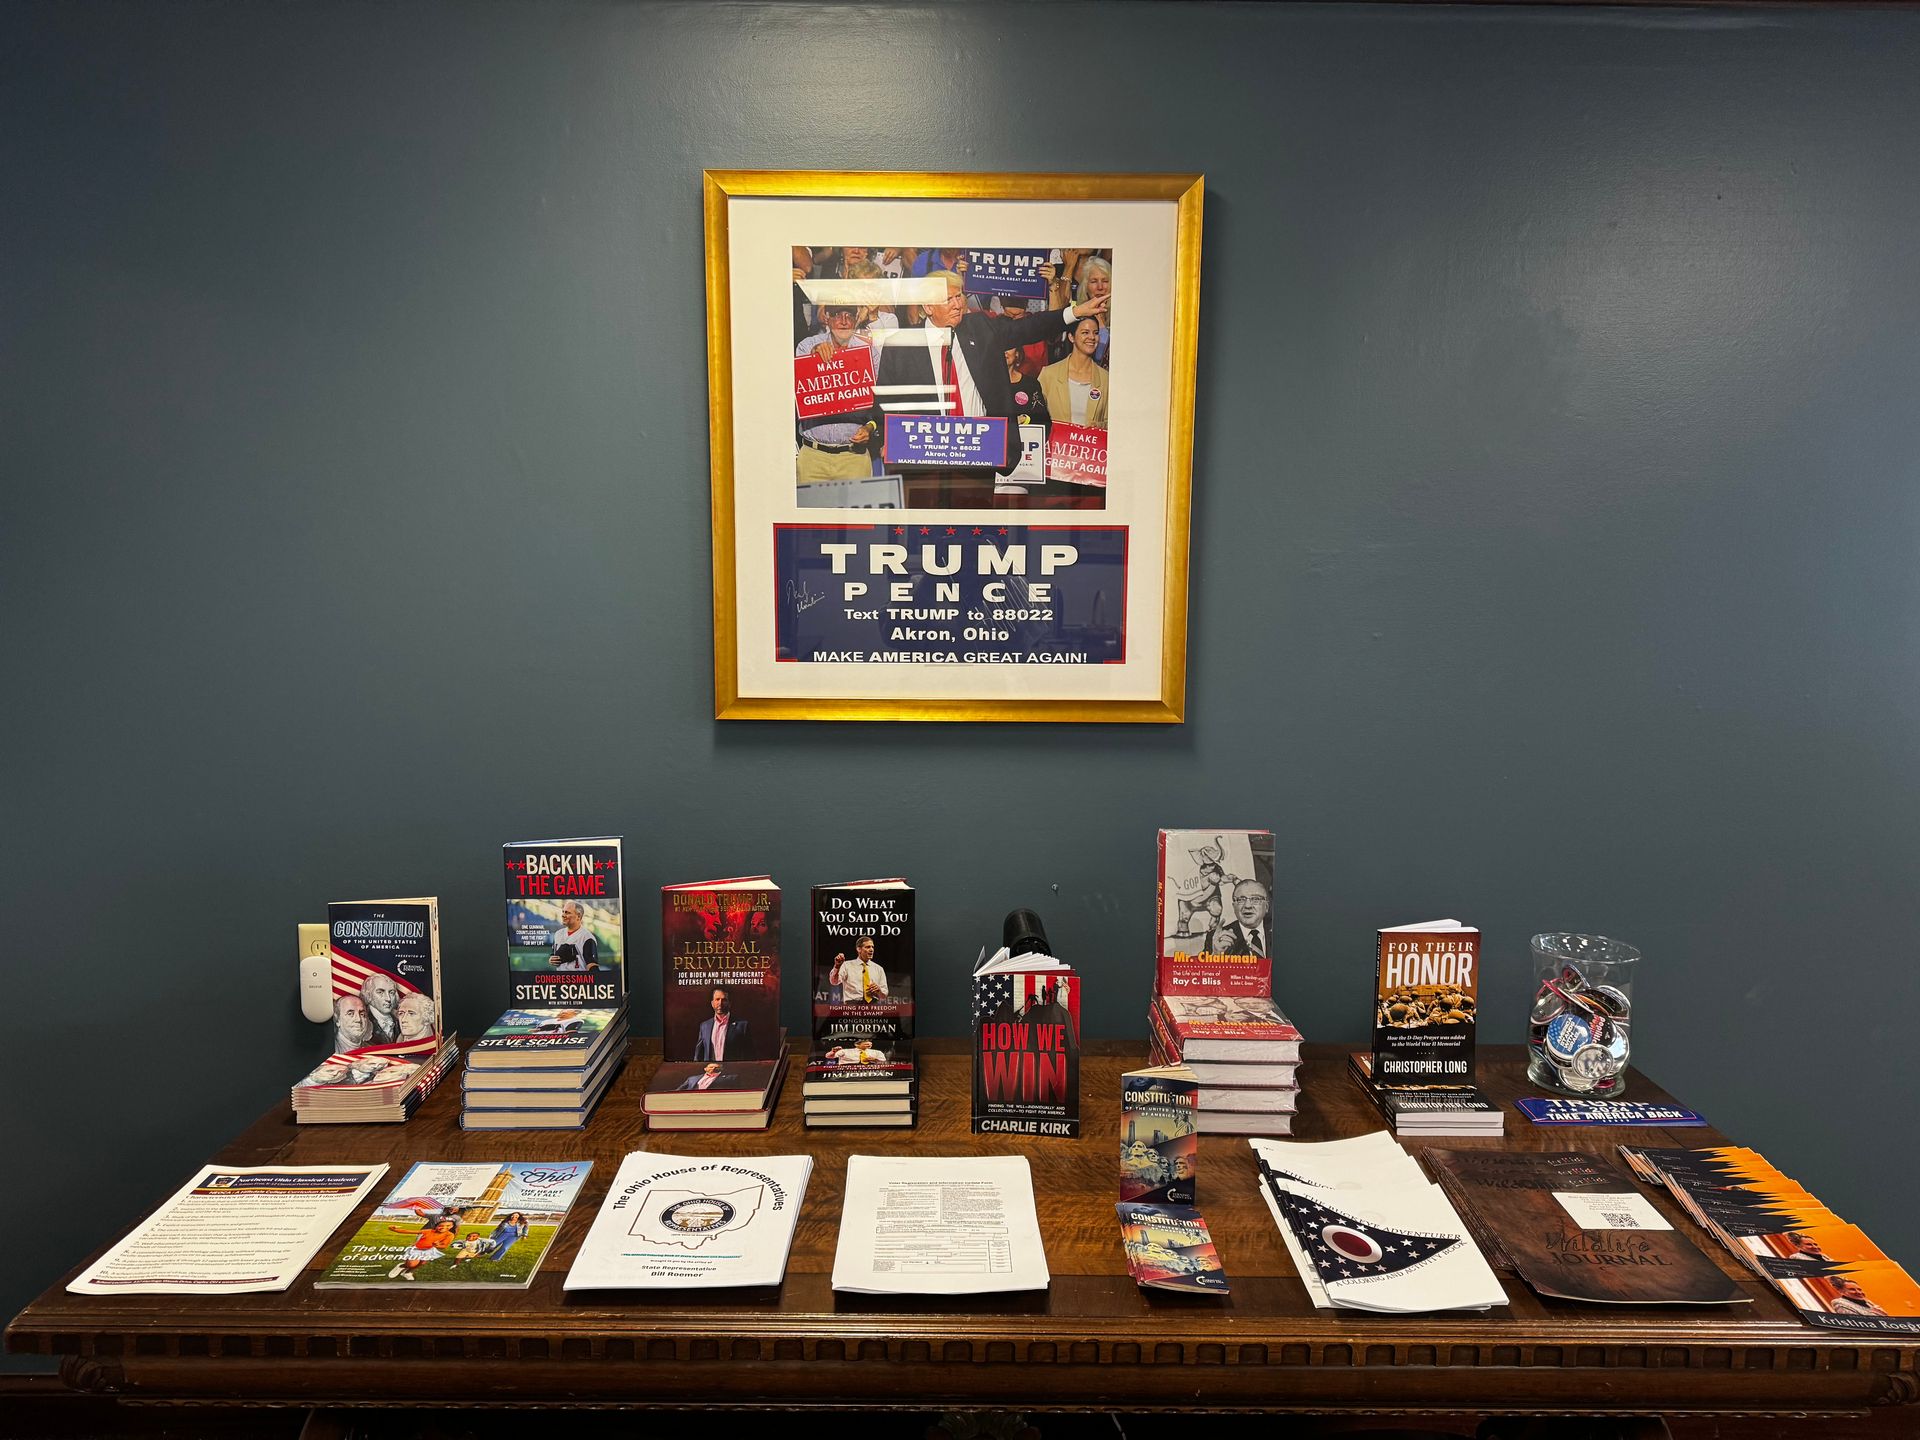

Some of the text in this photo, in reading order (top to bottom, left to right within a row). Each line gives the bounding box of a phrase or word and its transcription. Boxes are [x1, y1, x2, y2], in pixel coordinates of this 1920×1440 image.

[970, 252, 1044, 267] TRUMP
[975, 265, 1036, 276] PENCE
[817, 360, 845, 372] MAKE
[796, 369, 873, 394] AMERICA
[803, 386, 870, 406] GREAT AGAIN
[901, 421, 990, 435] TRUMP
[909, 435, 980, 444] PENCE
[1070, 432, 1098, 444] MAKE
[1045, 440, 1107, 463] AMERIC
[1046, 458, 1107, 475] GREAT AGAI
[820, 543, 1079, 576] TRUMP
[844, 582, 1053, 603] PENCE
[844, 609, 1054, 621] Text TRUMP to 88022
[890, 627, 1010, 643] Akron, Ohio
[813, 652, 1088, 664] MAKE AMERICA GREAT AGAIN!
[526, 855, 594, 875] BACK IN
[517, 875, 606, 895] THE GAME
[1184, 877, 1199, 890] GOP
[673, 894, 771, 905] DONALD TRUMP JR.
[334, 921, 424, 937] CONSTITUTION
[685, 941, 760, 954] LIBERAL
[1389, 942, 1473, 952] FOR THEIR
[673, 956, 771, 970] PRIVILEGE
[1174, 951, 1257, 964] Mr. Chairman
[1386, 952, 1472, 988] HONOR
[535, 975, 594, 984] CONGRESSMAN
[1172, 978, 1189, 986] Ray
[516, 984, 615, 1000] STEVE SCALISE
[830, 1024, 896, 1034] JIM JORDAN
[526, 1037, 588, 1045] SCALISE
[982, 1023, 1065, 1052] HOW WE
[1384, 1060, 1442, 1073] CHRISTOPHER
[1444, 1061, 1467, 1074] LONG
[983, 1052, 1066, 1103] WIN
[1545, 1099, 1649, 1107] TRUMP
[1586, 1111, 1642, 1120] AMERICA
[981, 1120, 1070, 1135] CHARLIE KIRK
[520, 1171, 578, 1183] Ohio
[613, 1196, 630, 1210] The
[629, 1178, 651, 1194] Ohio
[651, 1166, 696, 1180] House
[721, 1165, 787, 1211] Representatives
[1329, 1206, 1461, 1240] BUCKEYE ADVENTURER
[1546, 1229, 1650, 1256] Wildlife
[1342, 1276, 1385, 1286] COLORING
[1386, 1271, 1404, 1280] AND
[1405, 1255, 1443, 1275] ACTIVITY
[1443, 1240, 1468, 1258] BOOK
[1551, 1252, 1672, 1266] JOURNAL
[1818, 1315, 1878, 1329] Kristina
